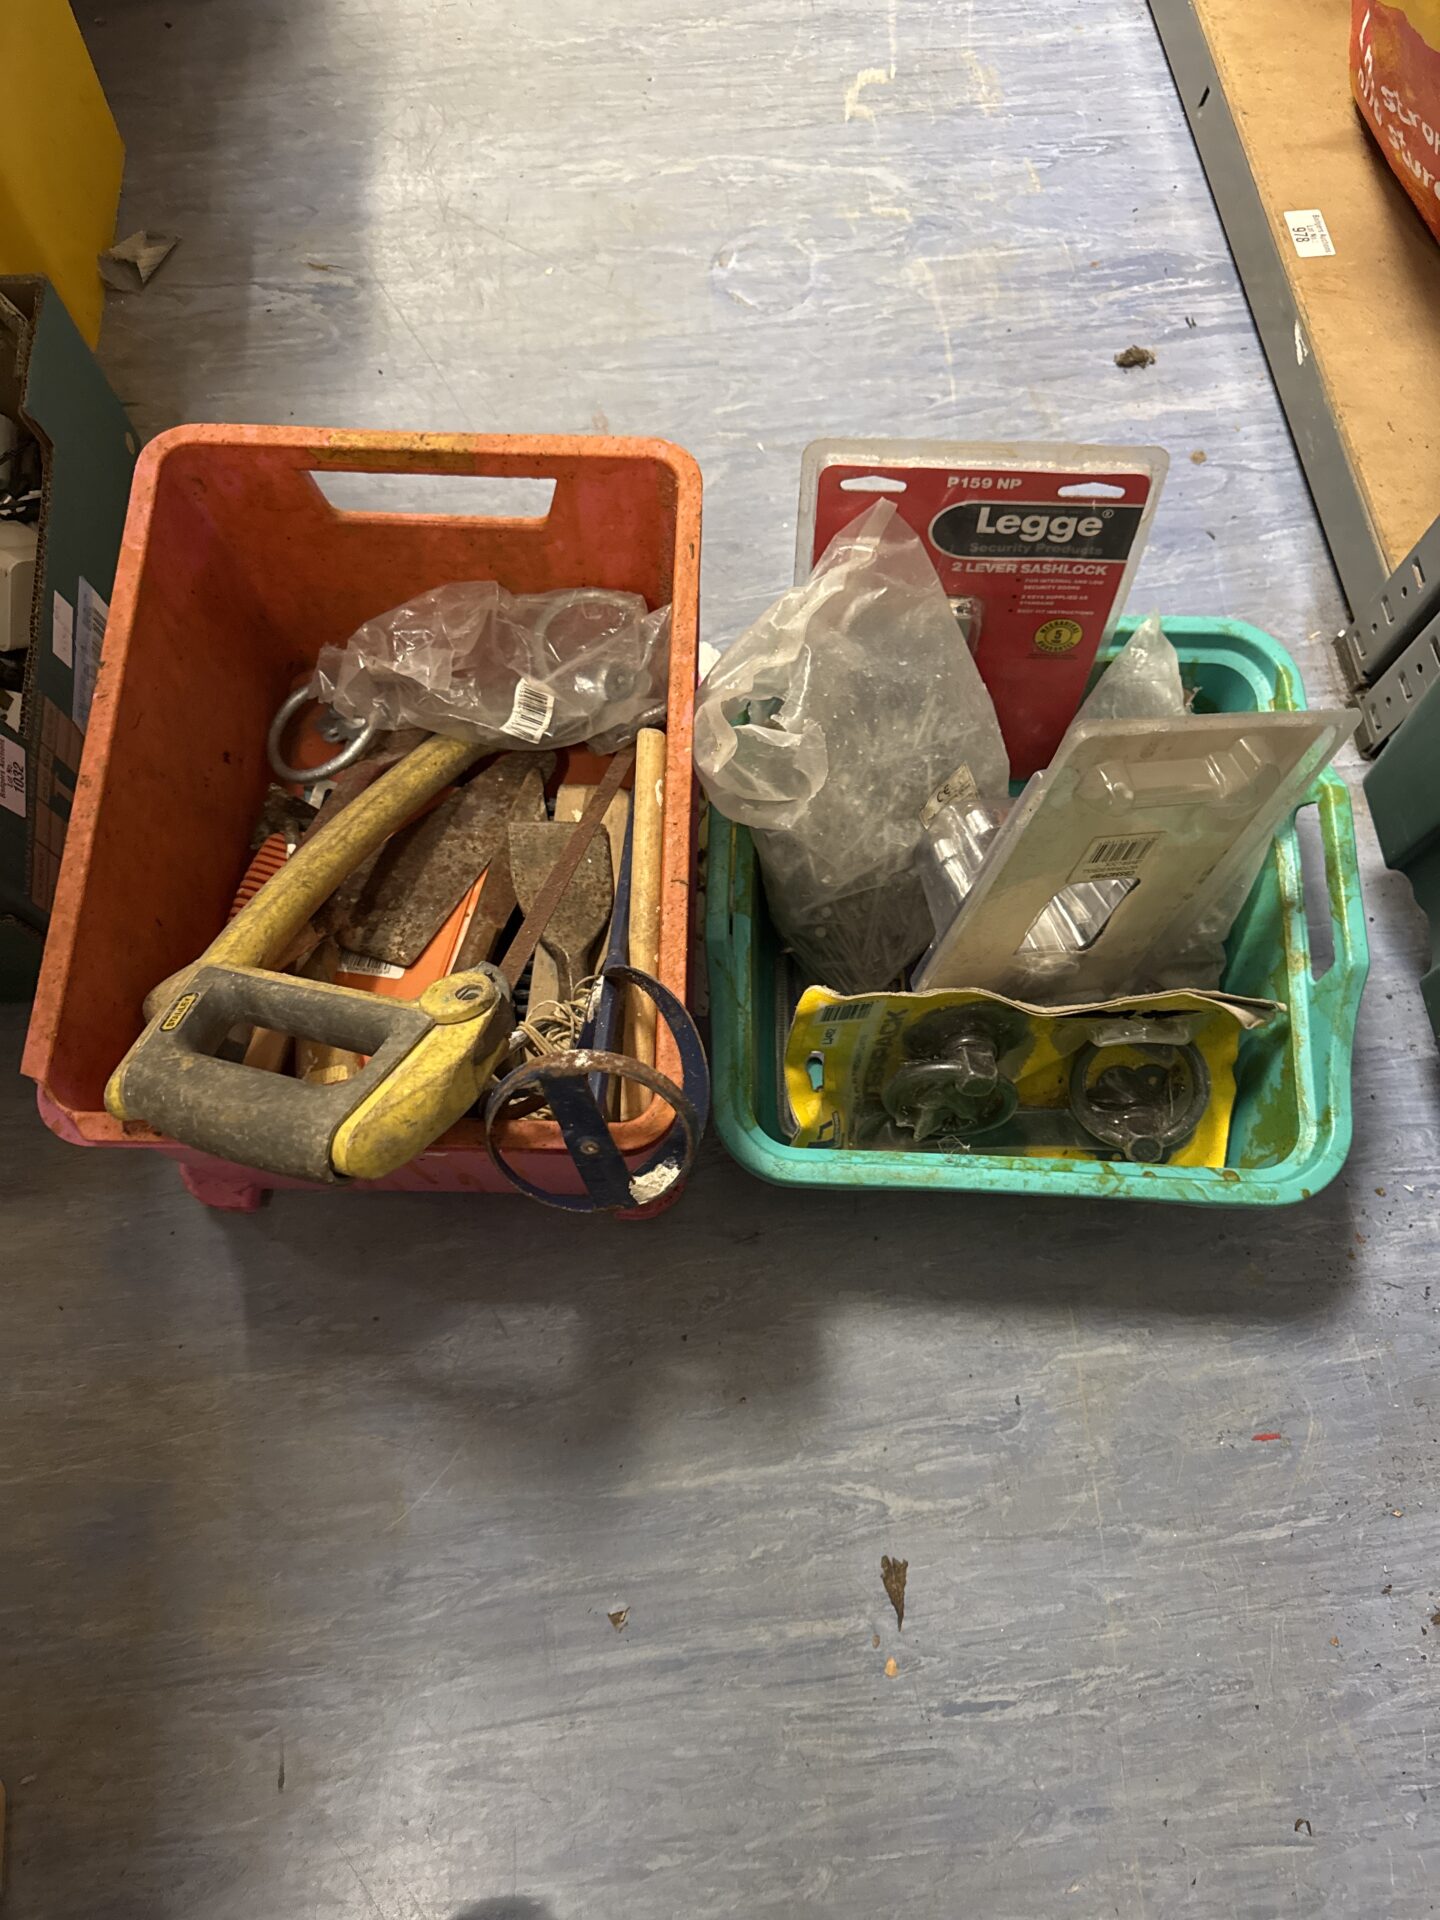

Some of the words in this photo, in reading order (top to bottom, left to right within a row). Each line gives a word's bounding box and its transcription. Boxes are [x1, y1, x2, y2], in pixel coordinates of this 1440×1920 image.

[1292, 227, 1310, 242] 978
[947, 476, 993, 490] P159
[997, 478, 1022, 490] NP
[976, 507, 1103, 543] Legge
[970, 542, 1032, 556] Security
[1036, 543, 1104, 556] Products
[952, 562, 962, 571] 2
[965, 563, 1017, 574] LEVER
[1020, 564, 1108, 575] SASHLOCK
[13, 761, 25, 794] 1032
